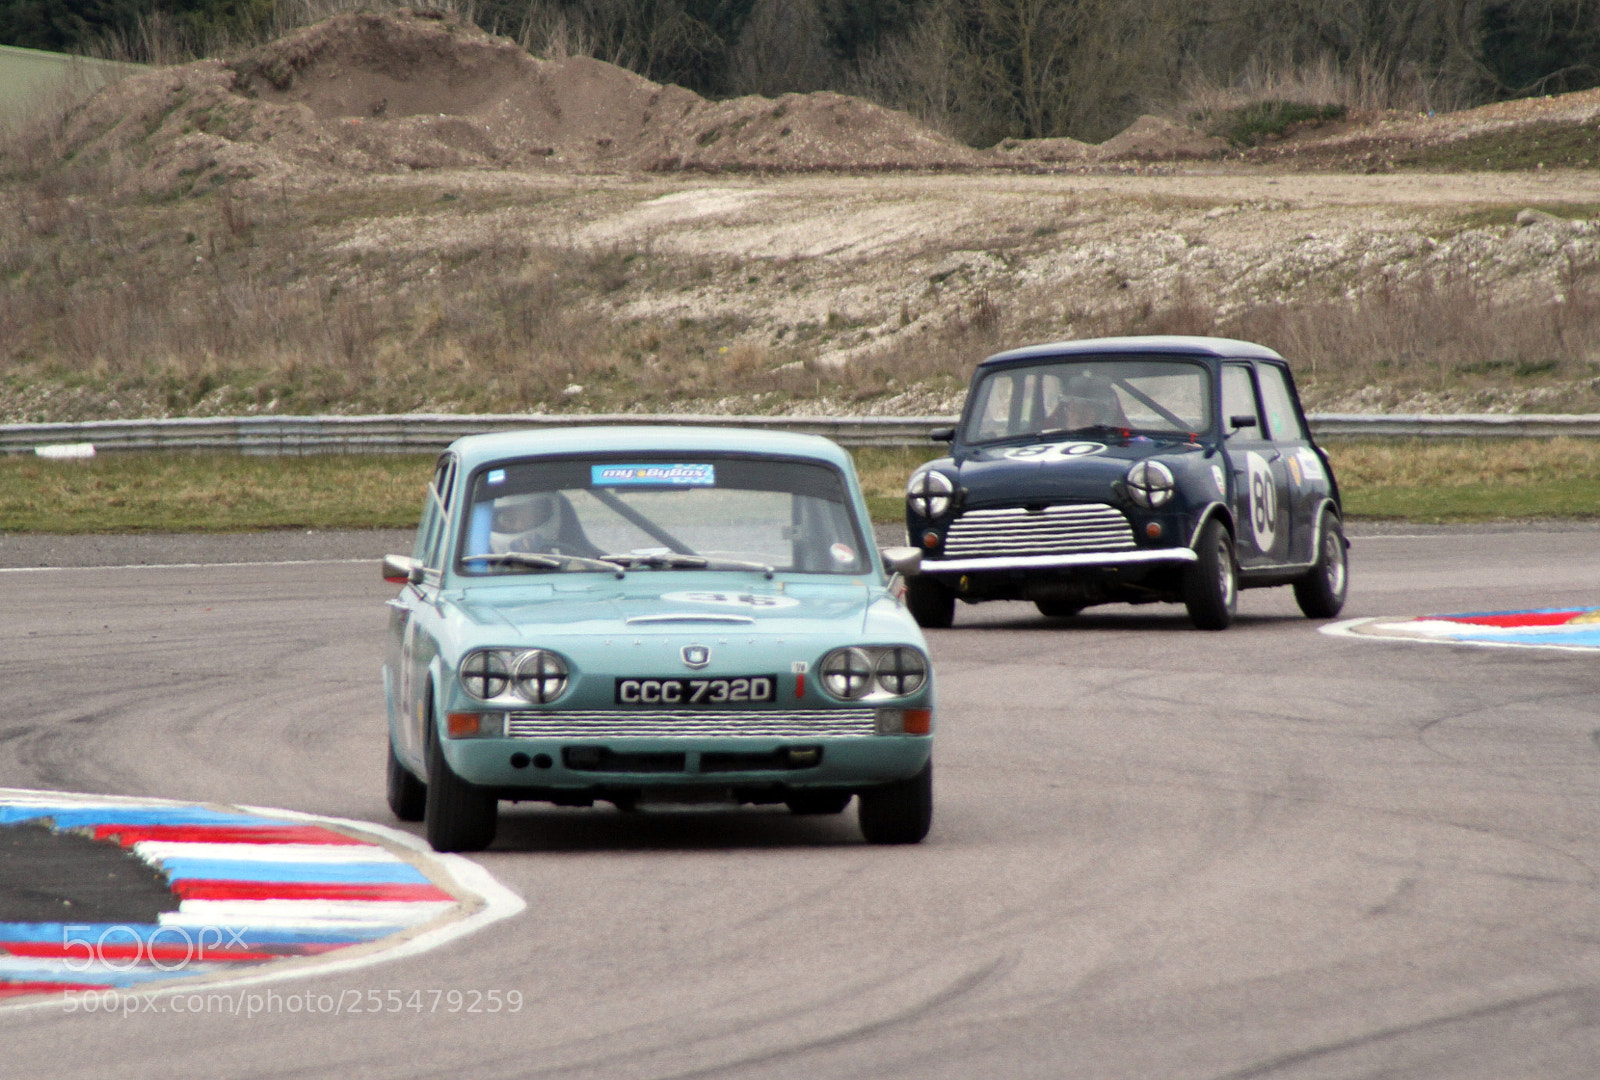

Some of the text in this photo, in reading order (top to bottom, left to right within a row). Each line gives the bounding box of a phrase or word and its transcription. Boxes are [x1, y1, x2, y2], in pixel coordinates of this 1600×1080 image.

[1008, 444, 1105, 456] 80
[602, 468, 634, 478] my
[1253, 471, 1276, 534] 80
[620, 678, 771, 703] CCC 732D
